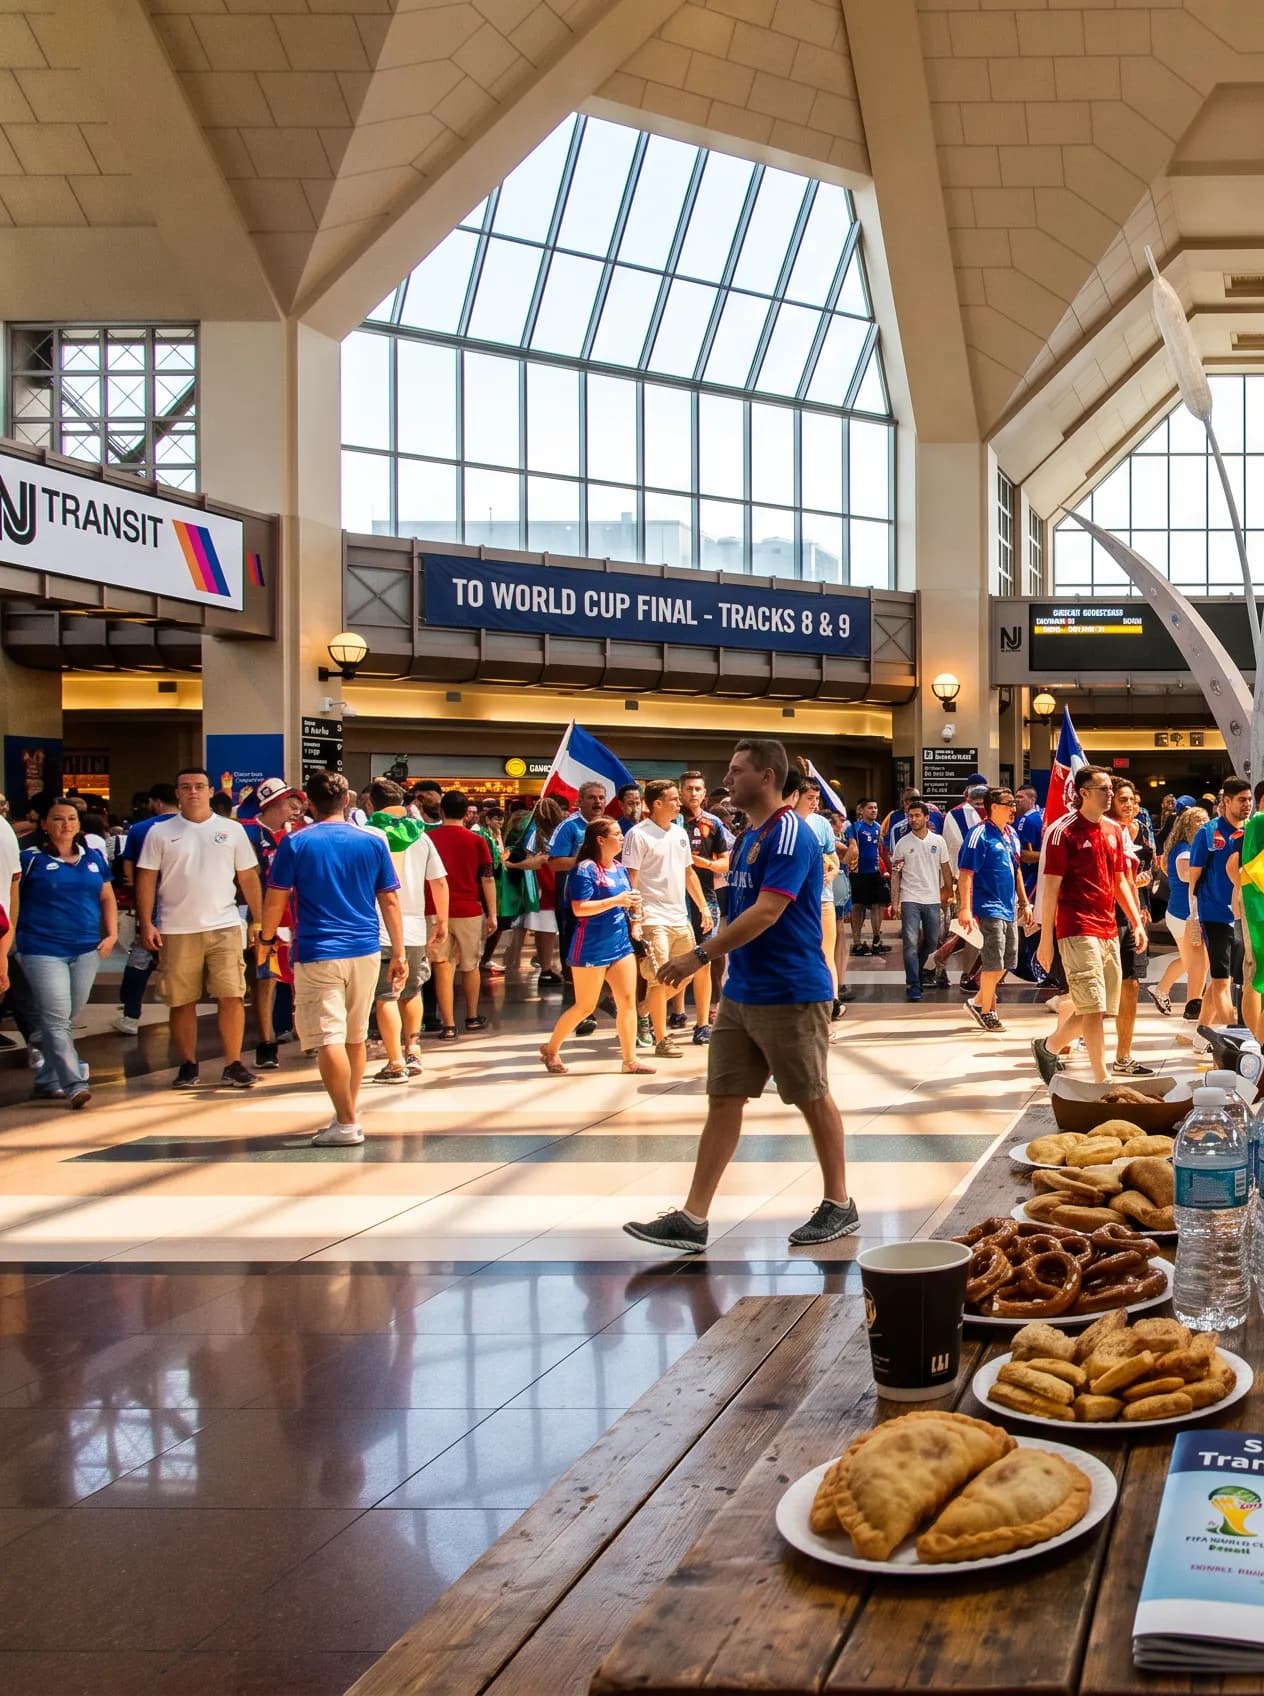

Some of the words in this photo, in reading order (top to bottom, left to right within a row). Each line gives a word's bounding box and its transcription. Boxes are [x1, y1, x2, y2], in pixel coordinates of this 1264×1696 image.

[41, 487, 164, 548] TRANSIT
[452, 578, 484, 608] TO
[490, 581, 577, 616] WORLD
[584, 590, 631, 619] CUP
[637, 594, 698, 625] FINAL
[718, 602, 796, 634] TRACKS
[801, 610, 813, 635] 8
[819, 611, 833, 637] &
[838, 614, 850, 638] 9
